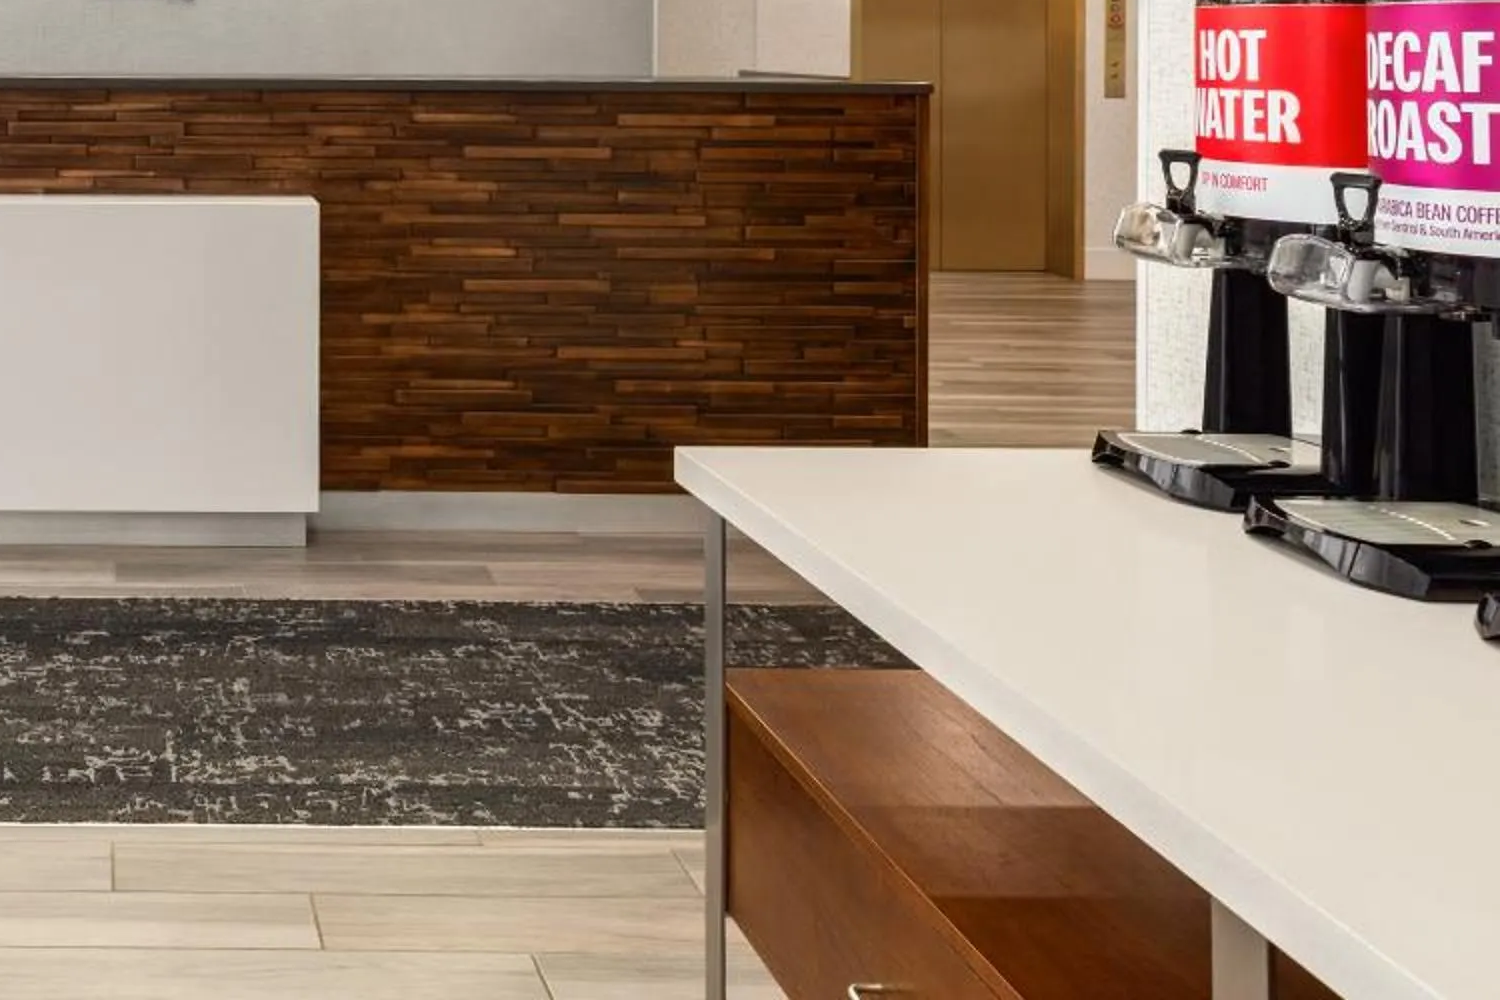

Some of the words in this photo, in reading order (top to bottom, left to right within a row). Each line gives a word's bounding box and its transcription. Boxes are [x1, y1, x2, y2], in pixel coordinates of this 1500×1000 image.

[1199, 28, 1268, 82] HOT
[1366, 31, 1495, 93] DECAF
[1416, 202, 1451, 221] BEAN
